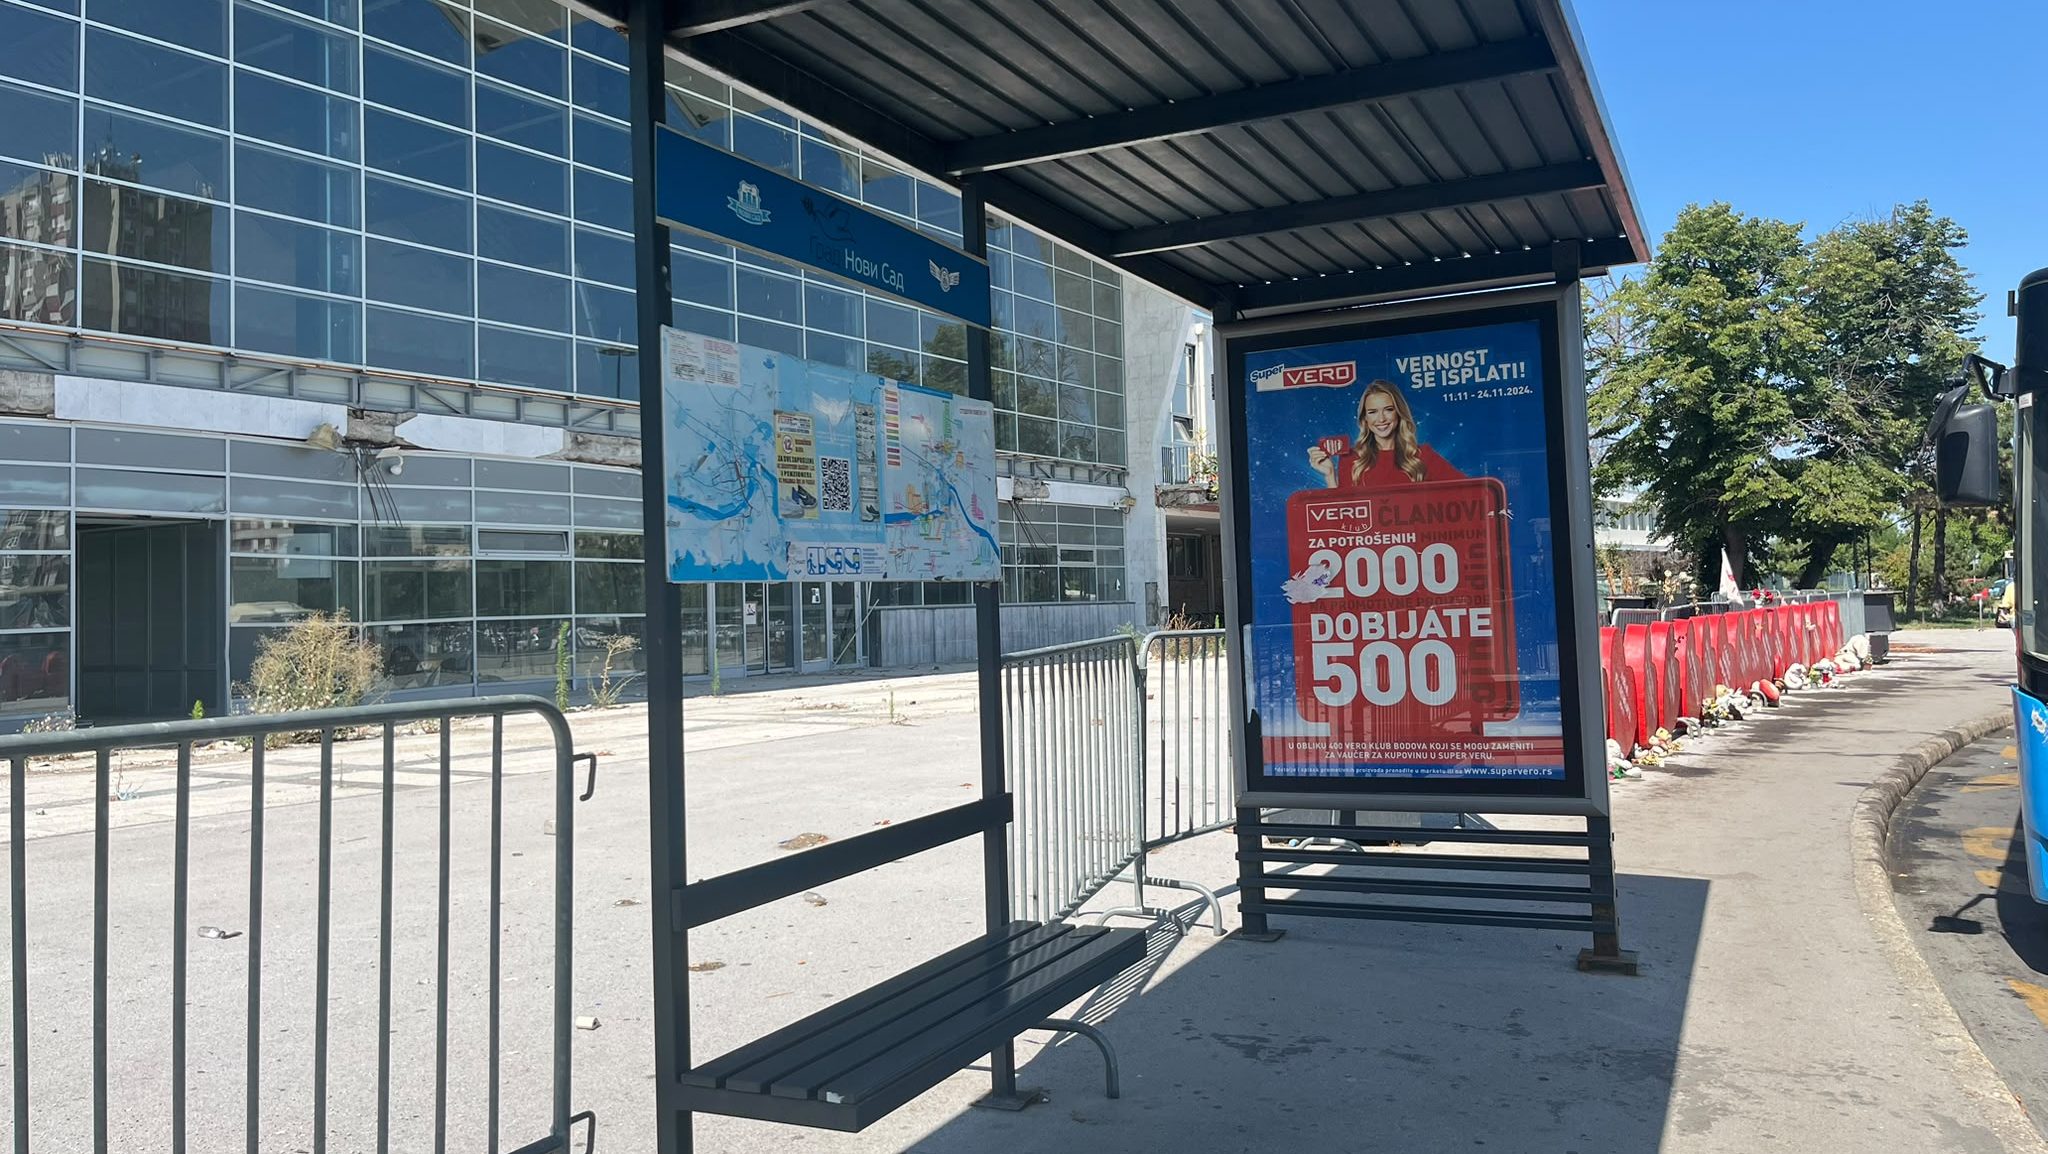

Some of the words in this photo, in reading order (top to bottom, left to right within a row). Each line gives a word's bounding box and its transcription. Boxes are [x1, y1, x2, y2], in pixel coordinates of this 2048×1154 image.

[844, 247, 879, 281] Нови
[881, 262, 905, 294] Сад
[1395, 348, 1489, 374] VERNOST
[1250, 364, 1285, 382] Super
[1286, 366, 1350, 385] VERO
[1411, 371, 1437, 389] SE
[1441, 361, 1526, 387] ISPLATI!
[1477, 385, 1534, 400] 24.11.2024.
[1309, 505, 1369, 522] VERO
[1378, 497, 1487, 527] ČLANOVI
[1340, 522, 1369, 532] klub
[1308, 538, 1325, 549] ZA
[1328, 531, 1417, 547] POTROŠENIH
[1308, 542, 1460, 599] 2000
[1330, 598, 1414, 611] PROMOTIVNE
[1310, 607, 1493, 642] DOBIJATE
[1311, 639, 1457, 707] 500
[1288, 742, 1294, 751] U
[1296, 742, 1326, 751] OBLIKU
[1328, 742, 1343, 751] 400
[1344, 742, 1367, 751] VERO
[1369, 742, 1392, 751] KLUB
[1394, 742, 1428, 751] BODOVA
[1429, 742, 1449, 751] KOJI
[1451, 742, 1462, 751] SE
[1463, 742, 1489, 751] MOGU
[1491, 742, 1534, 751] ZAMENITI
[1337, 750, 1370, 759] VAUČER
[1384, 752, 1428, 760] KUPOVINU
[1430, 752, 1436, 760] U
[1438, 752, 1467, 760] SUPER
[1469, 752, 1496, 760] VERU.
[1463, 767, 1553, 776] www.supervero.rs
